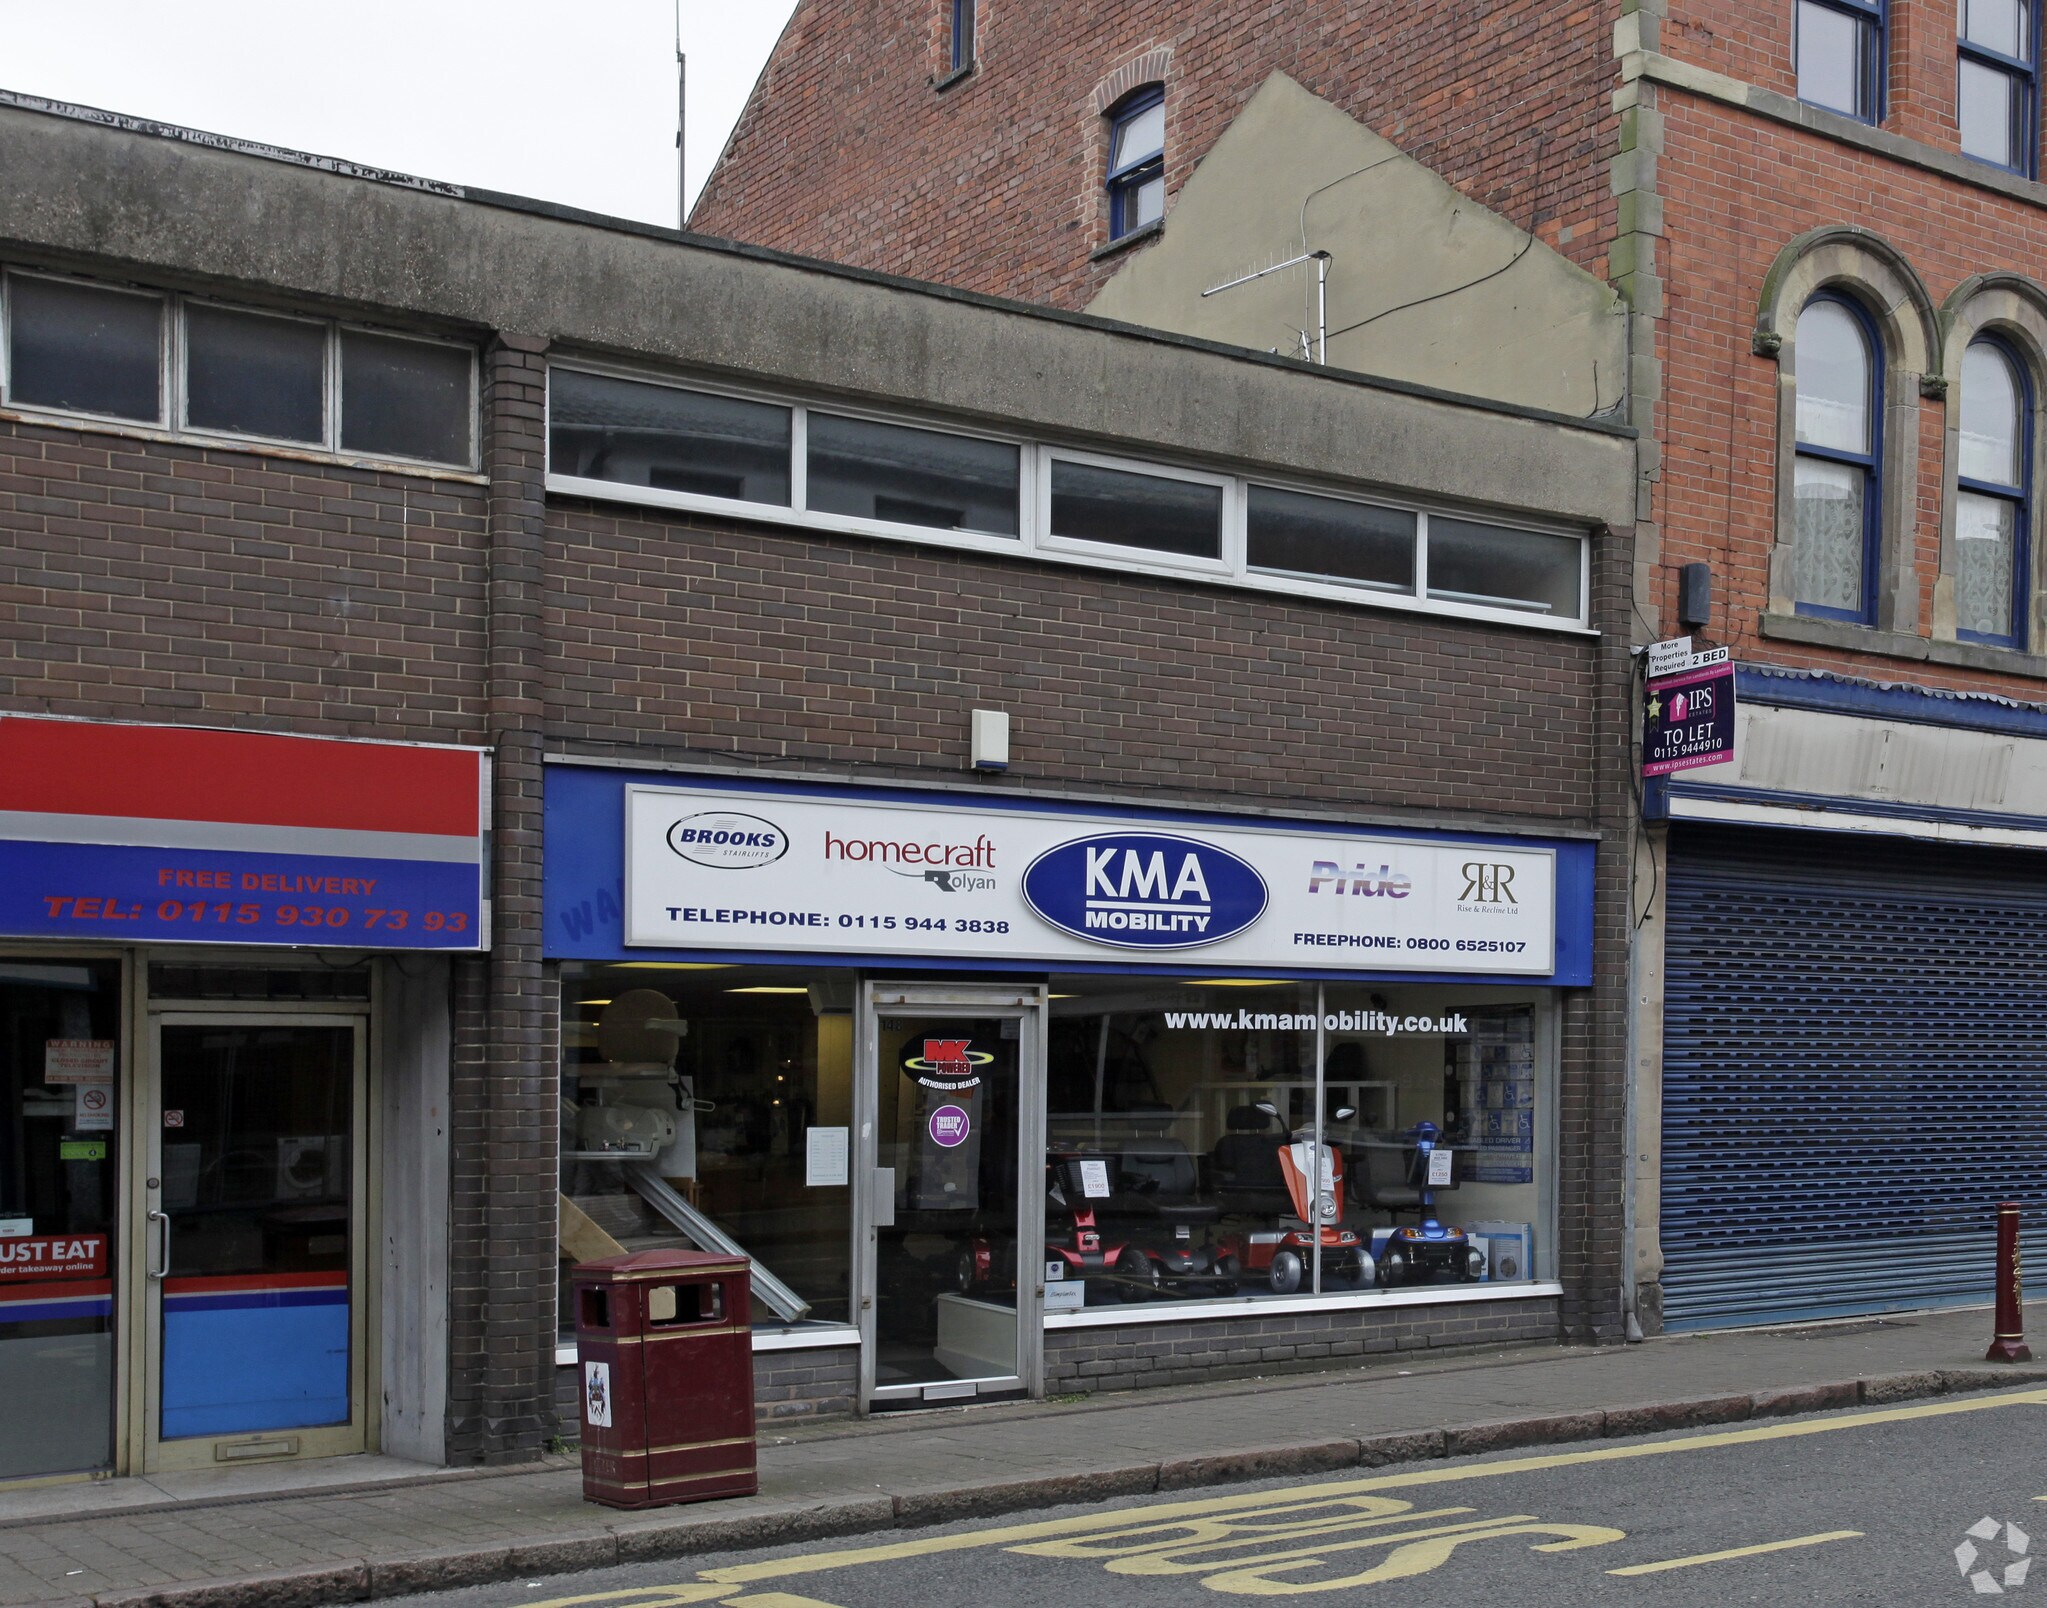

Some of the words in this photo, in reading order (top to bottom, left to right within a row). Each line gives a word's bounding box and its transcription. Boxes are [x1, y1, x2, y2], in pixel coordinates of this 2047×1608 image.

[1660, 642, 1678, 650] More
[1651, 651, 1688, 662] Properties
[1654, 660, 1686, 672] Required
[1692, 656, 1699, 665] 2
[1703, 649, 1727, 663] BED
[1689, 687, 1712, 711] IPS
[1688, 709, 1712, 717] ESTATES
[1664, 729, 1683, 746] TO
[1689, 722, 1714, 742] LET
[1654, 746, 1678, 759] 0115
[1681, 738, 1722, 755] 9444910
[1652, 753, 1723, 771] www.ipsestates.com
[680, 828, 776, 848] BROOKS
[723, 849, 770, 858] STAIRLIFTS
[825, 831, 997, 868] homecraft
[158, 869, 231, 889] FREE
[242, 873, 377, 896] DELIVERY
[924, 870, 997, 892] Rolyan
[1086, 847, 1211, 901] KMA
[1308, 860, 1412, 899] Pride
[43, 896, 142, 919] TEL:
[157, 900, 262, 925] 0115
[275, 905, 350, 927] 930
[363, 909, 409, 930] 73
[423, 911, 468, 932] 93
[1481, 906, 1505, 914] Recline
[666, 907, 830, 927] TELEPHONE:
[838, 914, 897, 929] 0115
[904, 917, 947, 931] 944
[954, 919, 1010, 934] 3838
[1085, 911, 1212, 932] MOBILITY
[1293, 933, 1401, 949] FREEPHONE:
[1406, 937, 1450, 951] 0800
[1455, 938, 1526, 953] 6525107
[1165, 1009, 1468, 1036] www.kmamobility.co.uk
[50, 1040, 110, 1048] WARNING
[924, 1039, 972, 1063] MK
[918, 1076, 956, 1089] AUTHORISED
[957, 1077, 981, 1089] DEALER
[52, 1240, 100, 1260] EAT
[0, 1266, 16, 1274] der
[19, 1265, 64, 1273] takeaway
[66, 1262, 94, 1270] online
